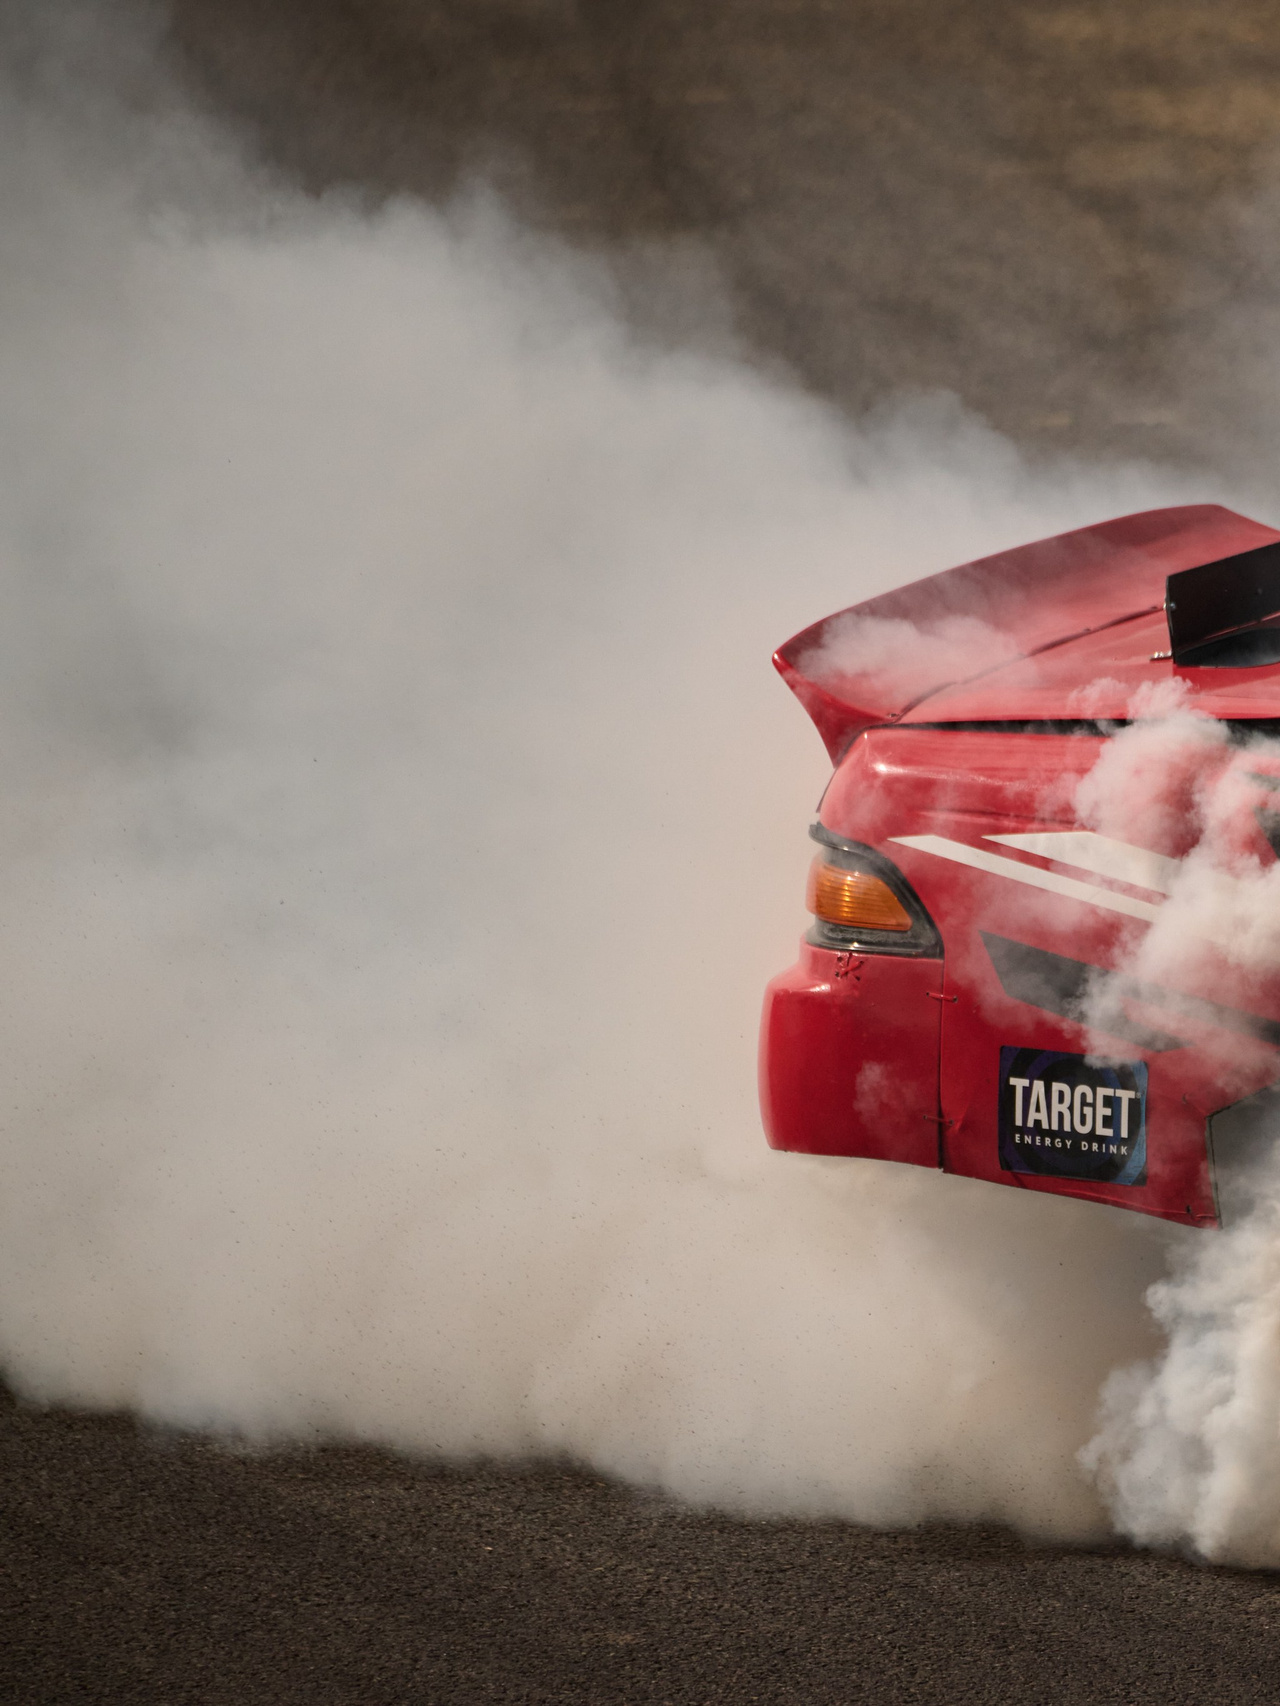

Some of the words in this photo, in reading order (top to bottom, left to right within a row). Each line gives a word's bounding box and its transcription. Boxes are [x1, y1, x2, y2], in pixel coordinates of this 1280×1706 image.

[1009, 1077, 1136, 1138] TARGET
[1015, 1134, 1072, 1149] ENERGY
[1081, 1141, 1128, 1156] DRINK
